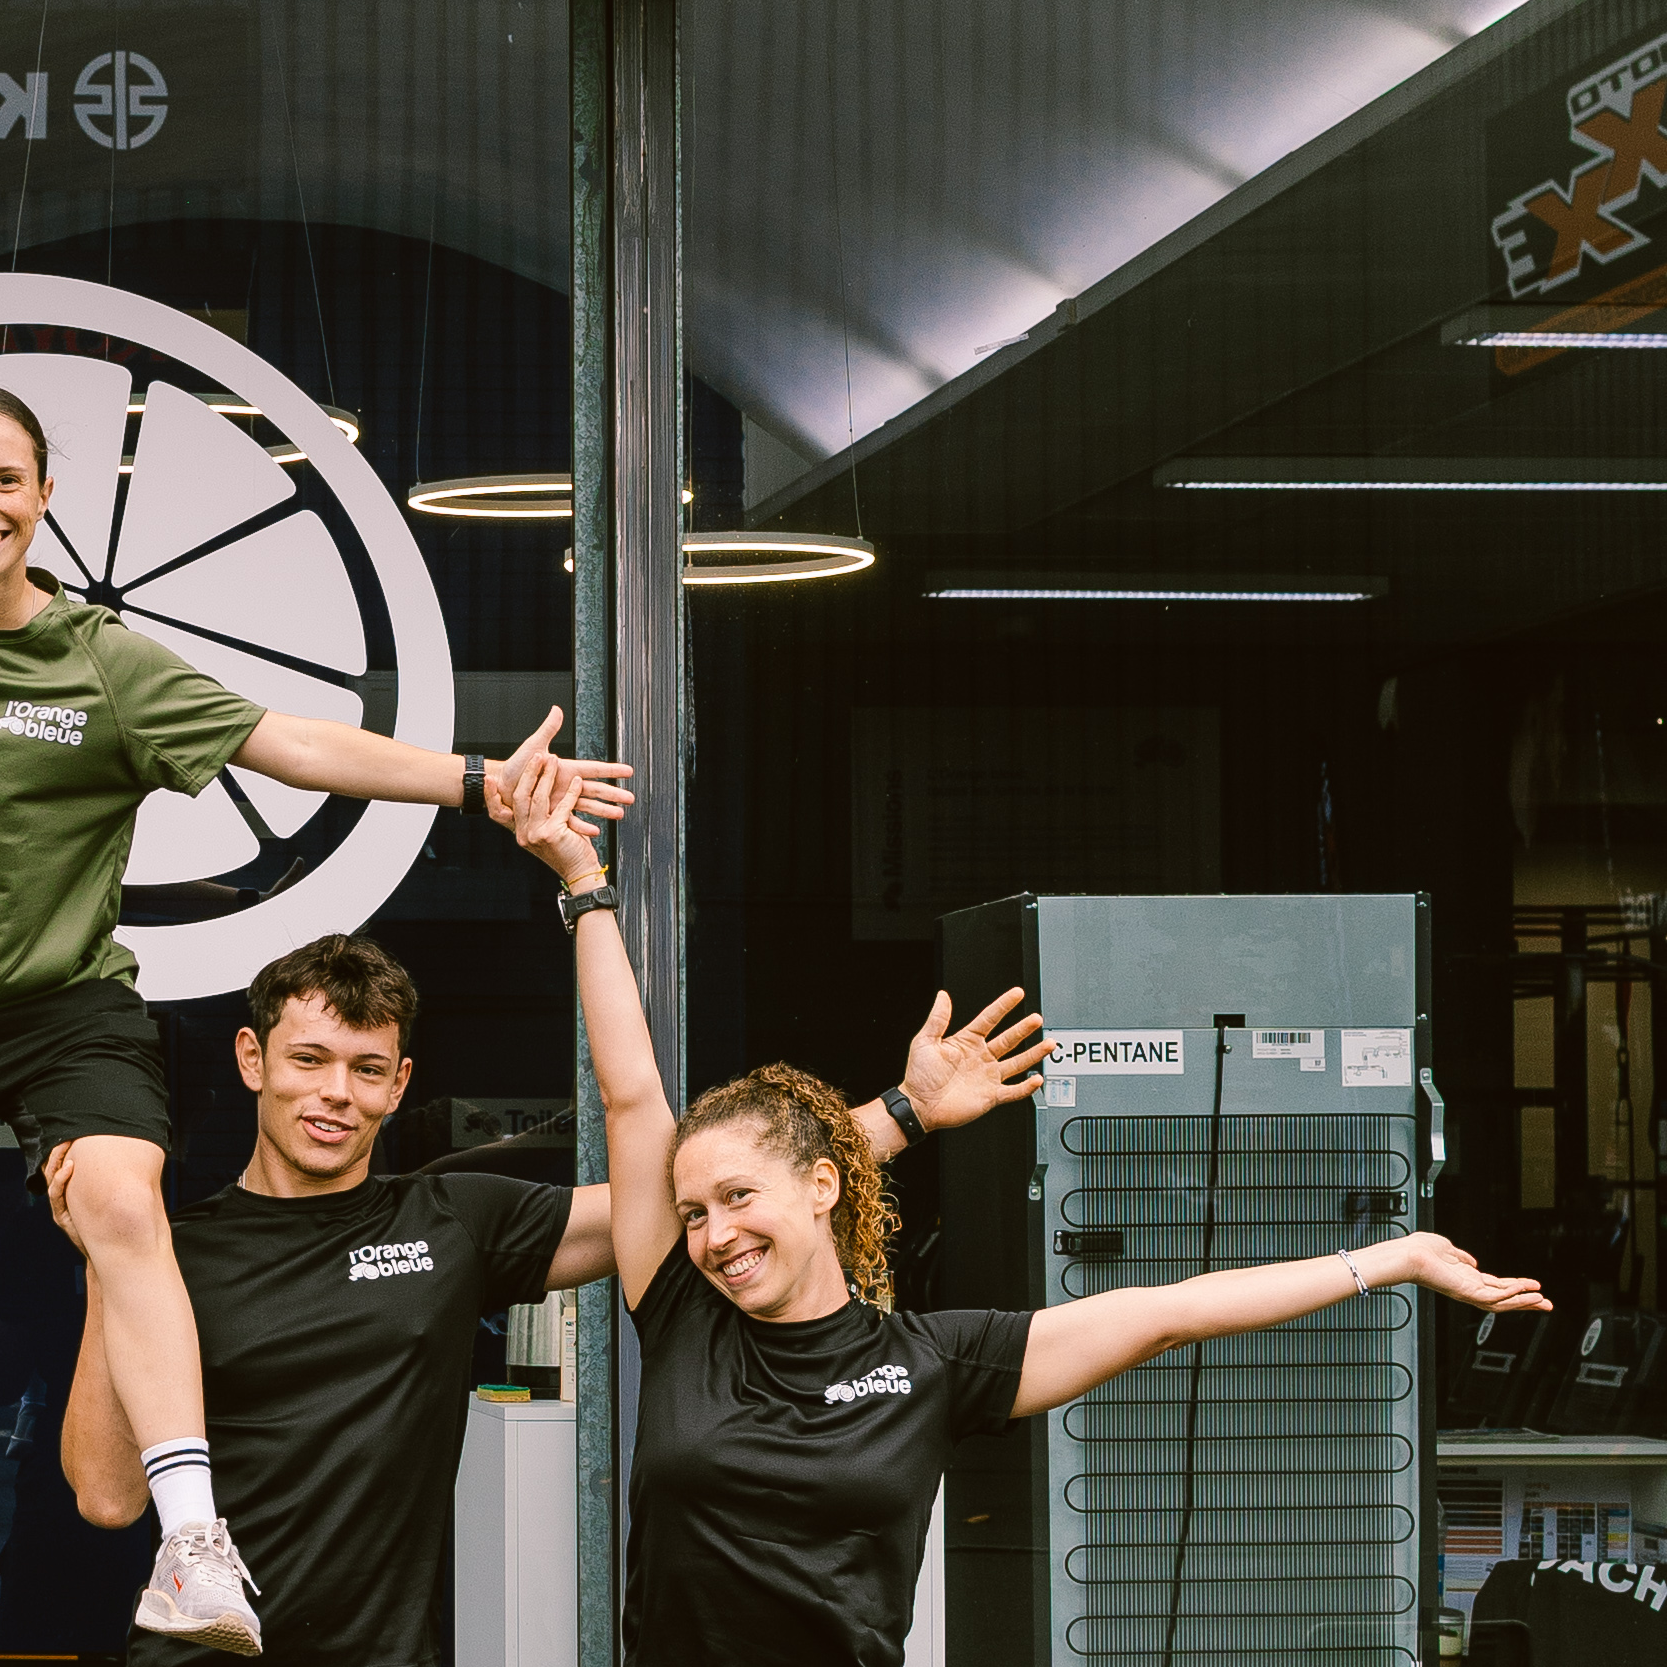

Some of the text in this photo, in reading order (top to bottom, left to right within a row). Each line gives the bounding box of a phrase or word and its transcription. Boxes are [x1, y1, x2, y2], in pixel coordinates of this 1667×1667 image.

[5, 701, 88, 729] l'Orange
[25, 719, 83, 746] bleue
[1049, 1041, 1179, 1064] C-PENTANE
[349, 1240, 429, 1264] l'Orange
[377, 1256, 434, 1277] bleue
[852, 1377, 911, 1397] bleue
